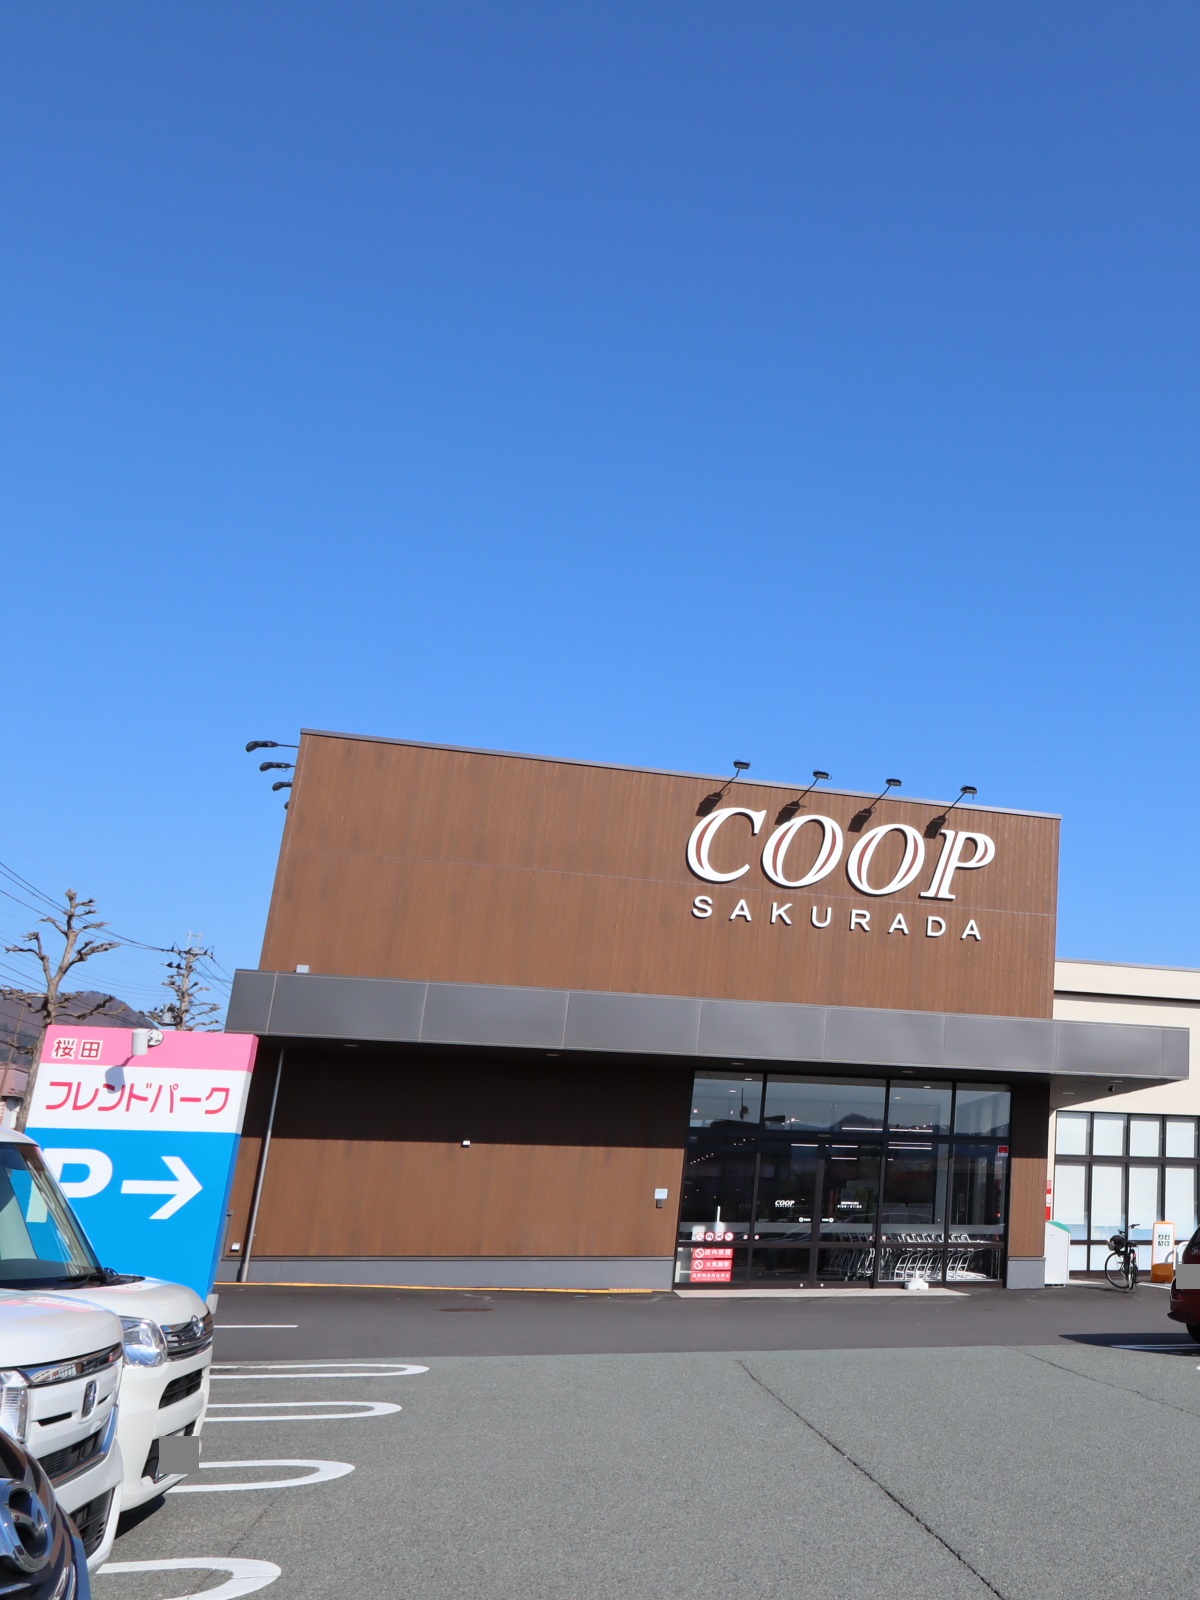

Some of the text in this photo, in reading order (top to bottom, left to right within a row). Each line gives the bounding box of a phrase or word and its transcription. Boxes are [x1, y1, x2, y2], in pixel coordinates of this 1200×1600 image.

[687, 807, 996, 899] COOP
[692, 895, 982, 940] SAKURADA
[53, 1038, 102, 1060] 桜田
[45, 1081, 230, 1115] フレンドパーク
[26, 1148, 113, 1223] P
